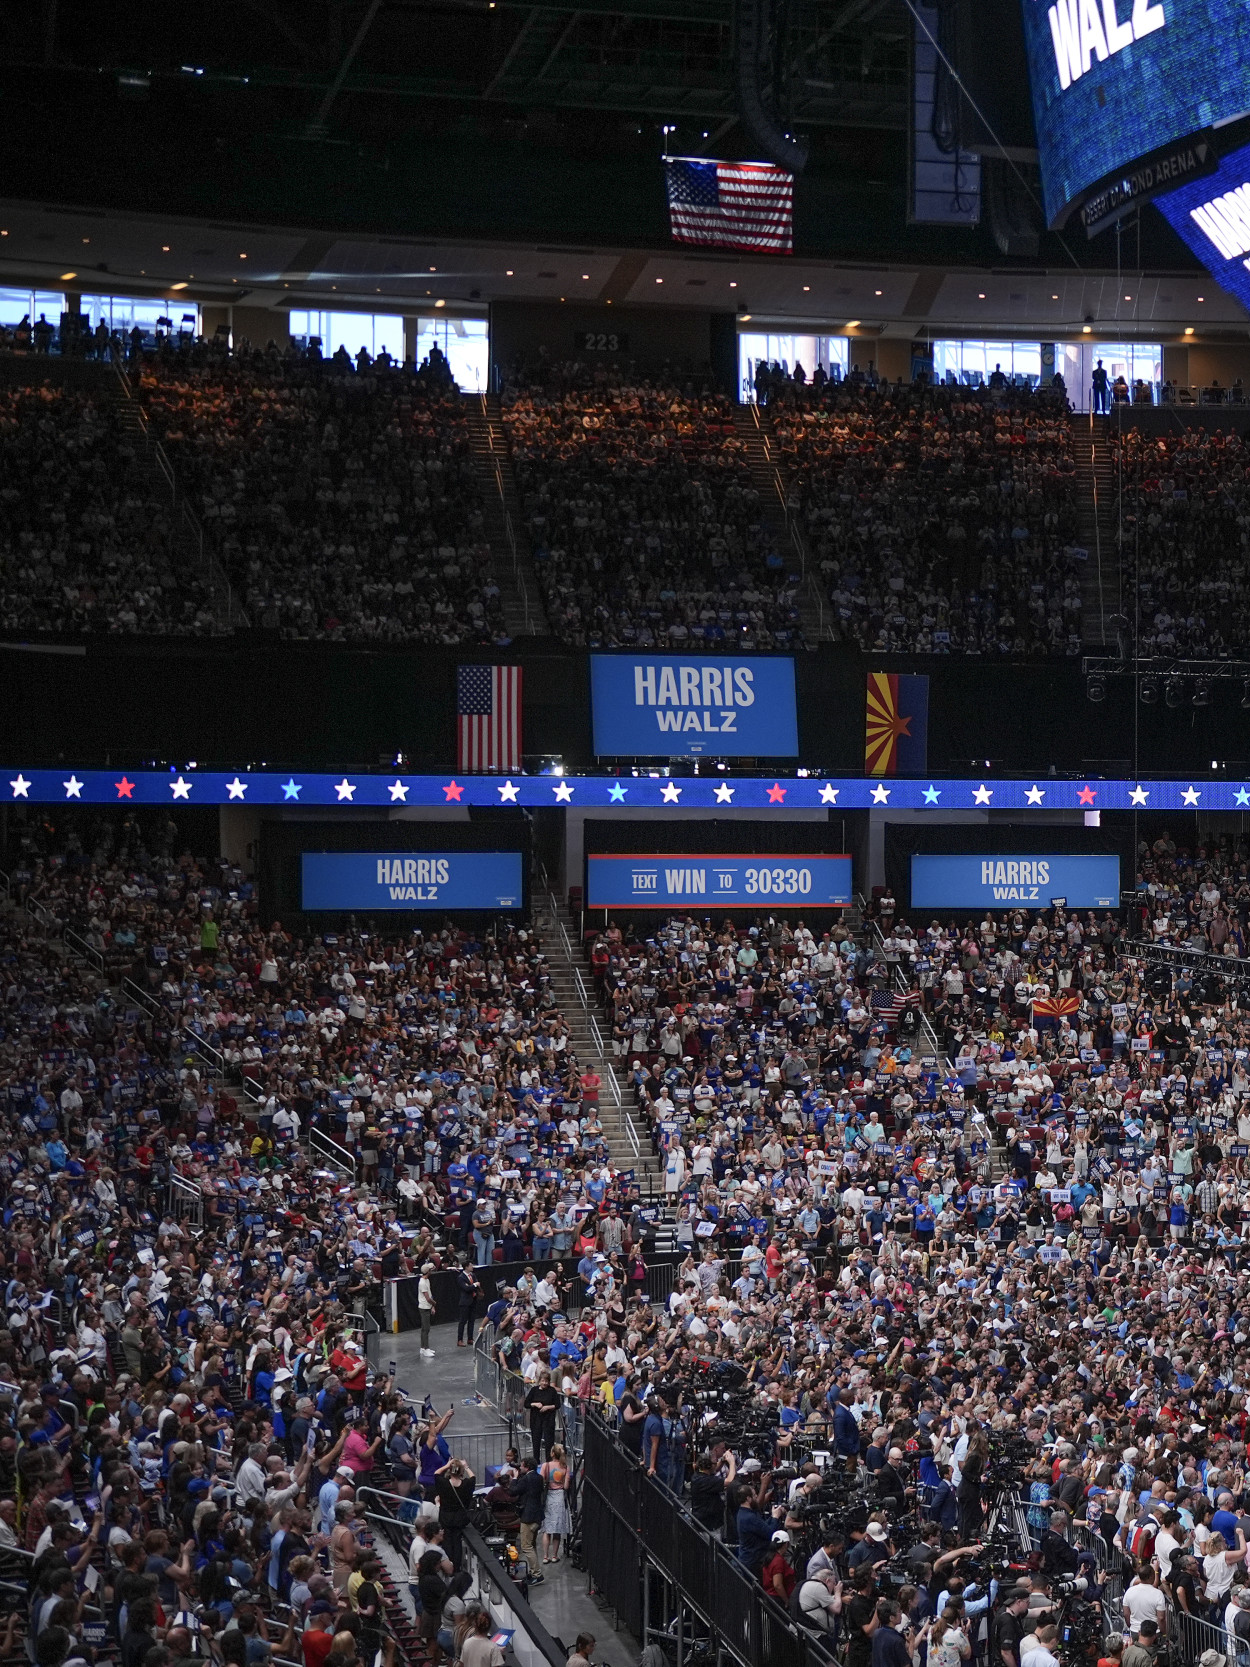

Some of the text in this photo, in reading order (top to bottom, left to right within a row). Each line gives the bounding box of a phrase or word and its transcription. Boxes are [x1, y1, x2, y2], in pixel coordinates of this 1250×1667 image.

[1156, 152, 1197, 187] ARENA
[586, 333, 618, 351] 223
[634, 666, 754, 707] HARRIS
[656, 711, 737, 732] WALZ
[377, 859, 449, 884] HARRIS
[632, 868, 812, 894] TEXT WIN TO 30330
[981, 861, 1050, 885] HARRIS
[389, 886, 438, 900] WALZ
[993, 886, 1039, 900] WALZ
